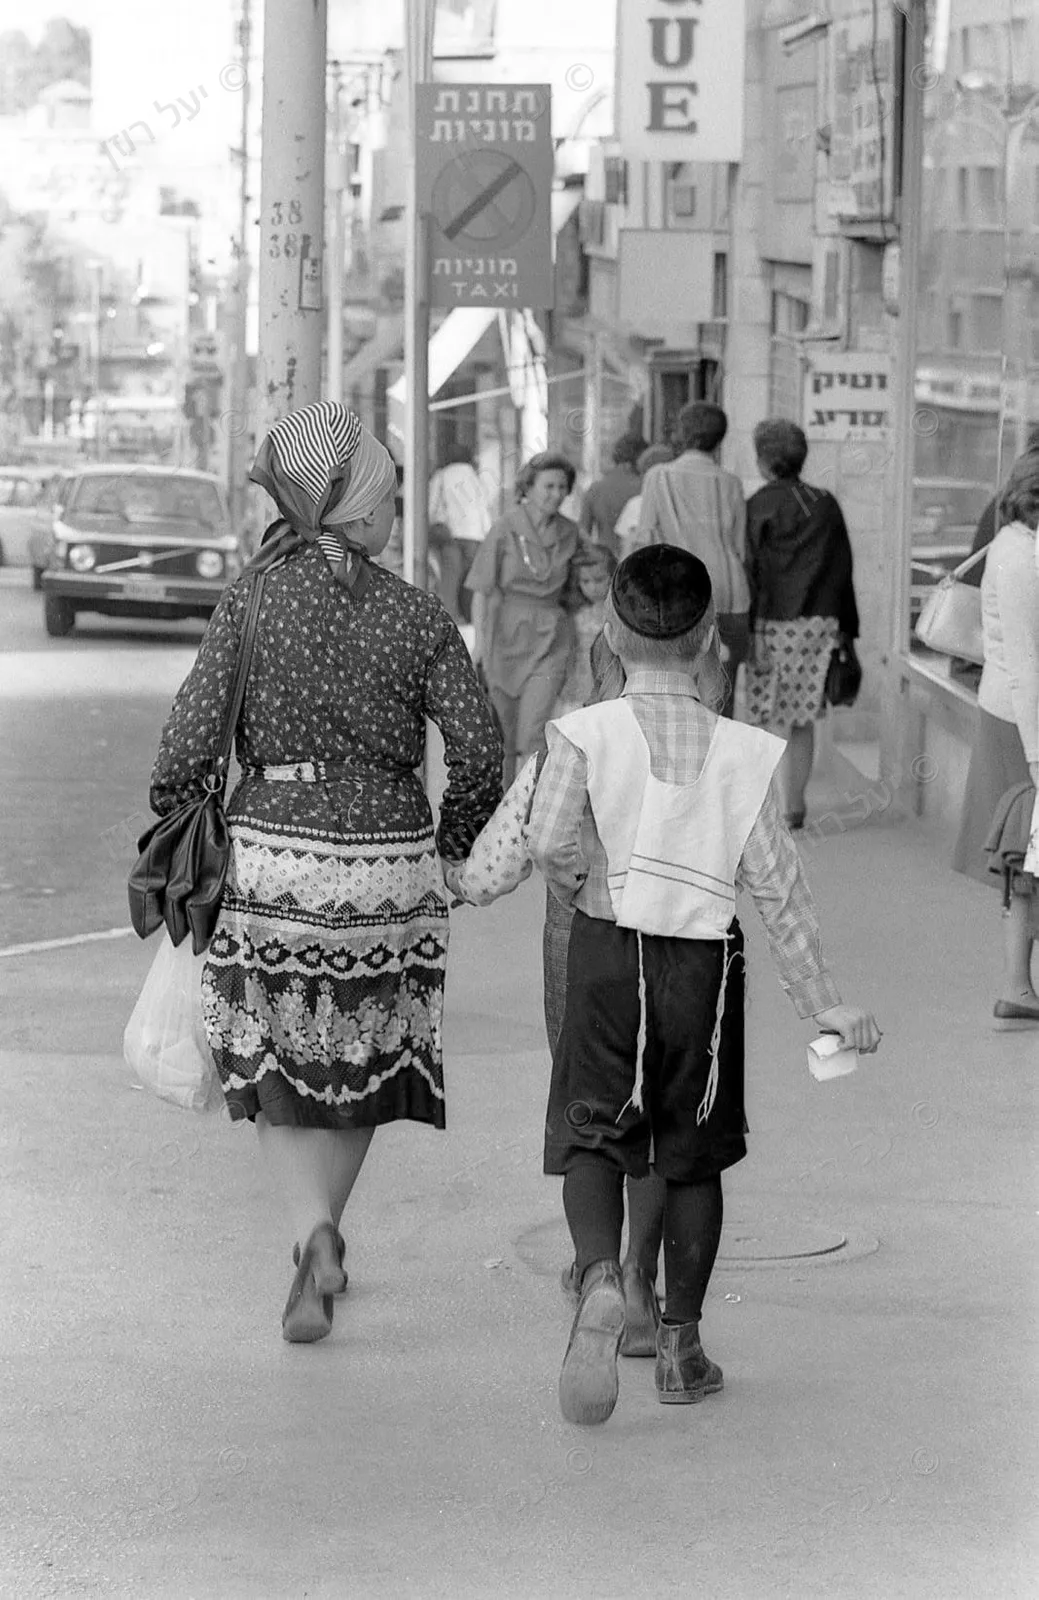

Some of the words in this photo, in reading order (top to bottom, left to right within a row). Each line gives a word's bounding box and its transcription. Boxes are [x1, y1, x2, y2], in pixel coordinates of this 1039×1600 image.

[644, 0, 702, 134] UE
[434, 90, 535, 113] תחנת
[429, 119, 536, 142] מוניות
[271, 200, 302, 226] 38
[432, 257, 518, 275] מוניות
[451, 281, 518, 297] TAXI
